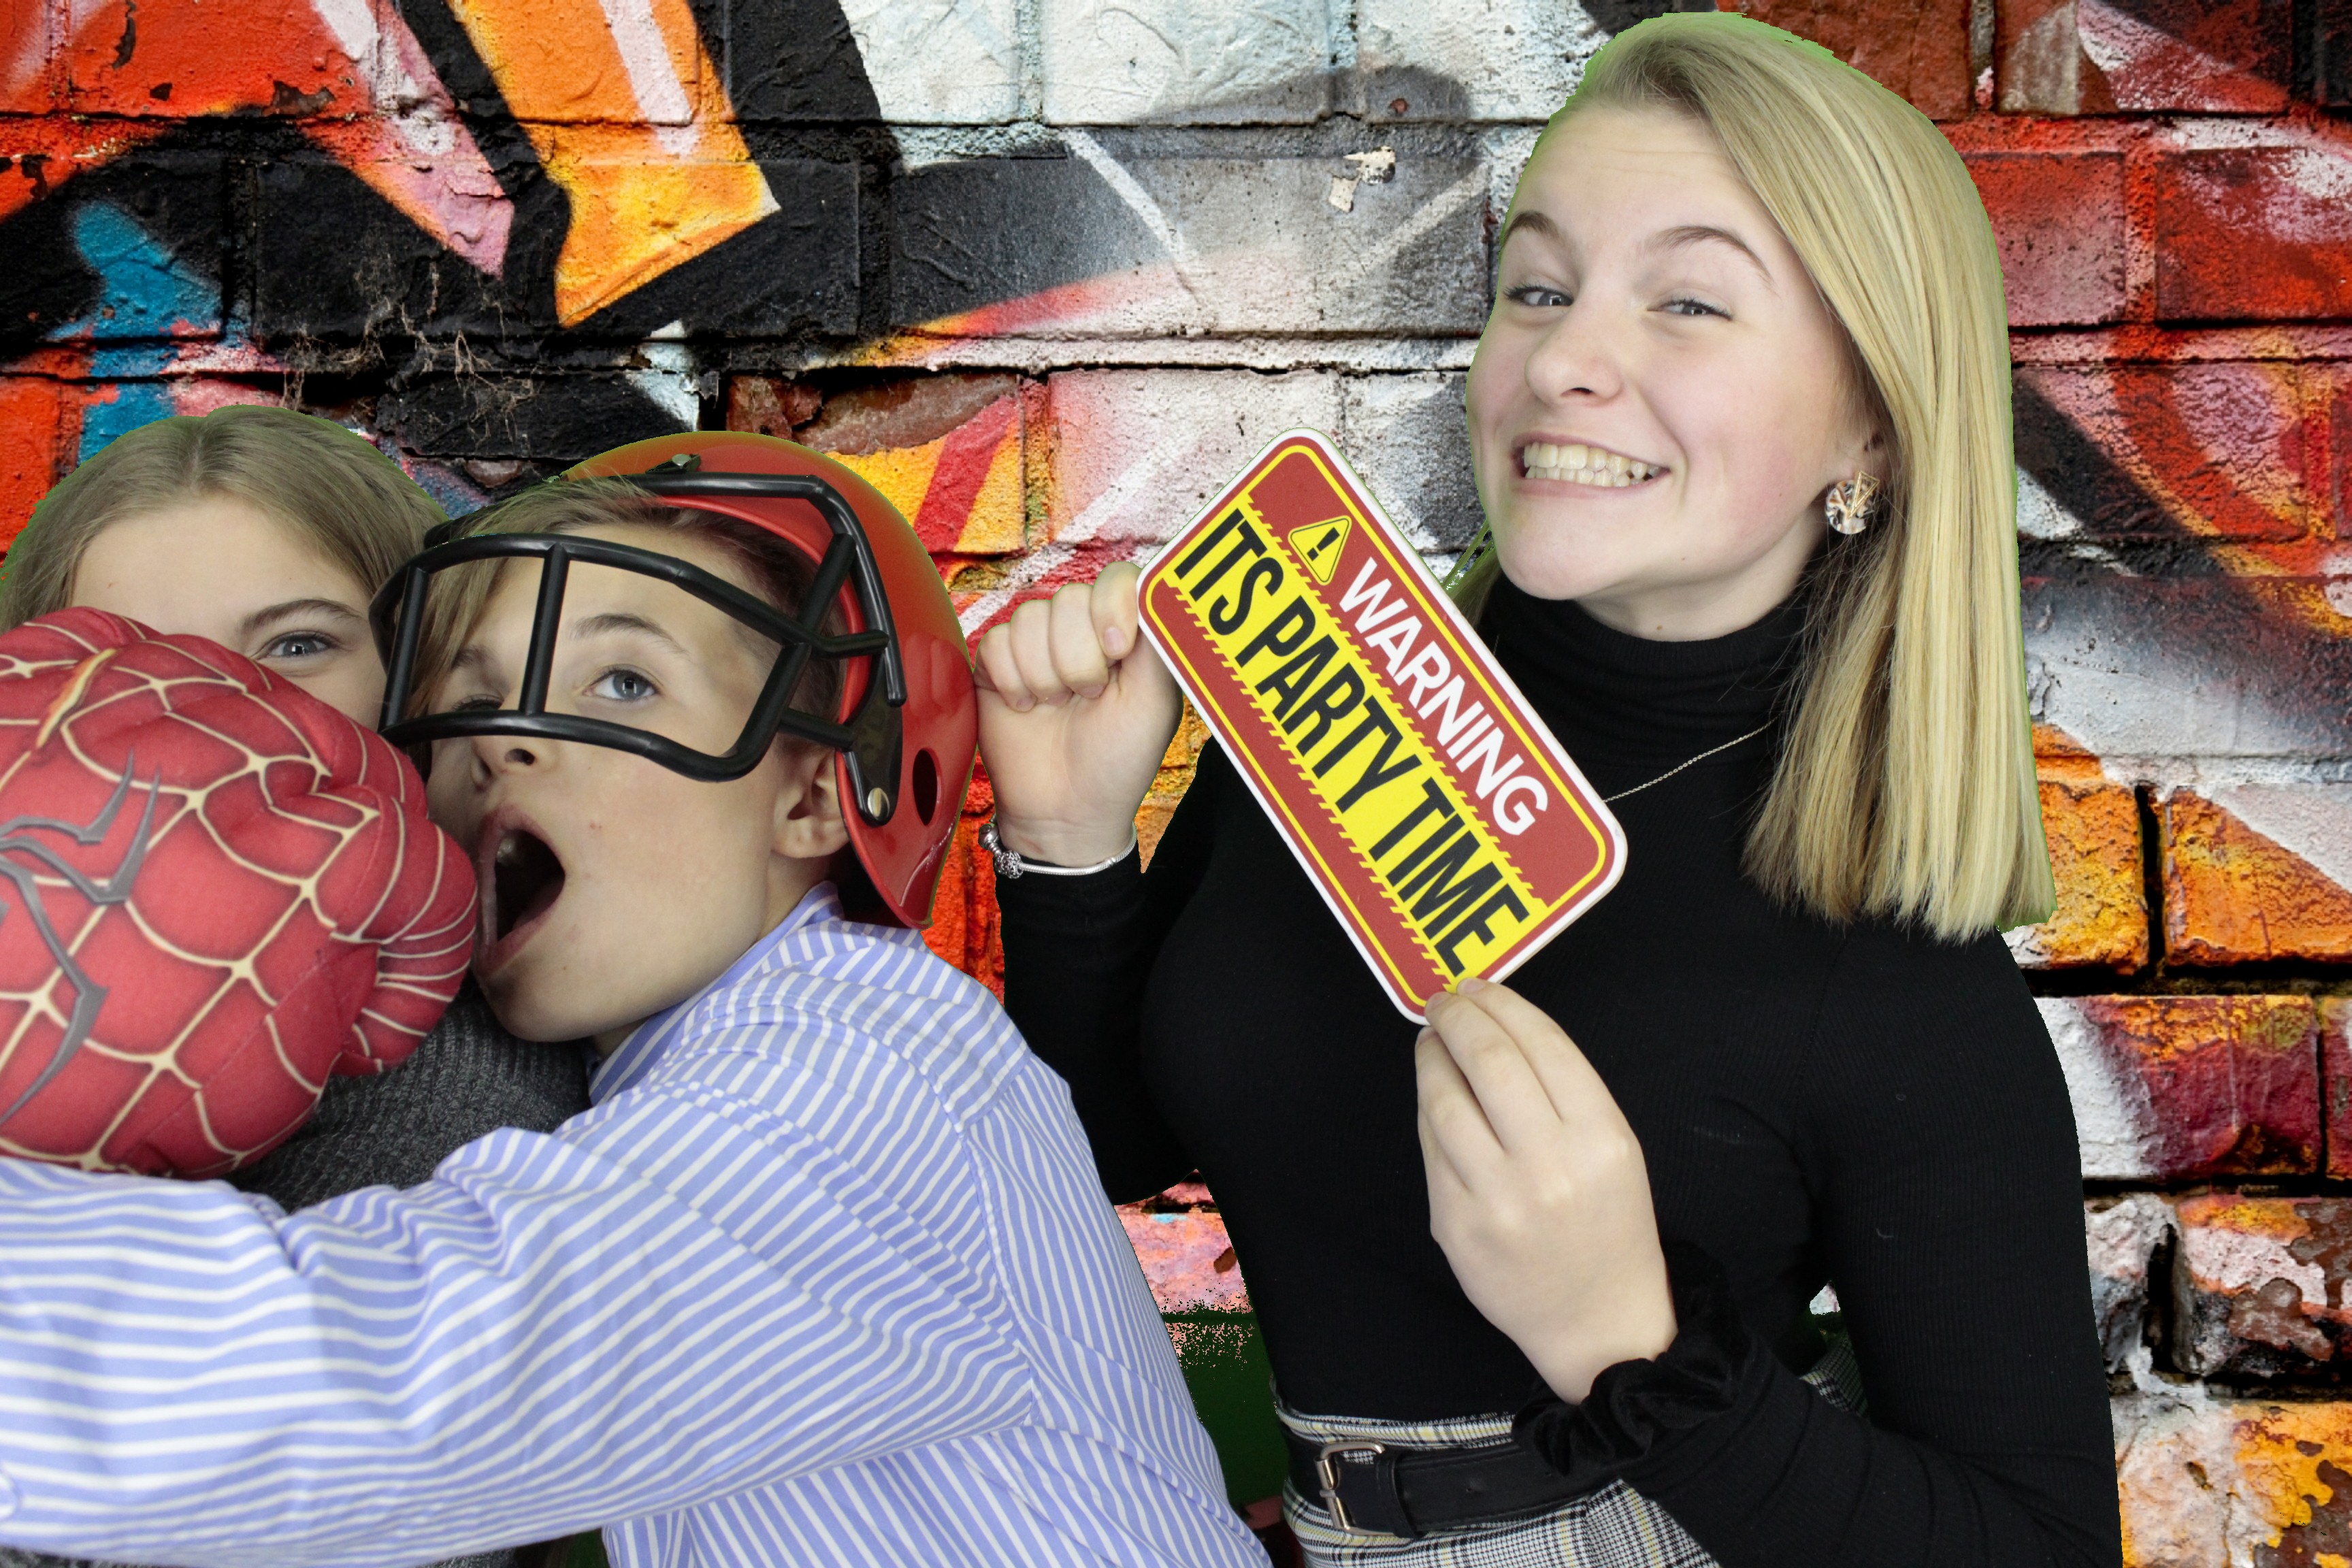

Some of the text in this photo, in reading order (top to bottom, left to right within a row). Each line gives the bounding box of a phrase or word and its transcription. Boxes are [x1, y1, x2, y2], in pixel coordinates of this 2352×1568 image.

[1174, 508, 1530, 977] ITS PARTY TIME
[1339, 557, 1548, 835] WARNING
